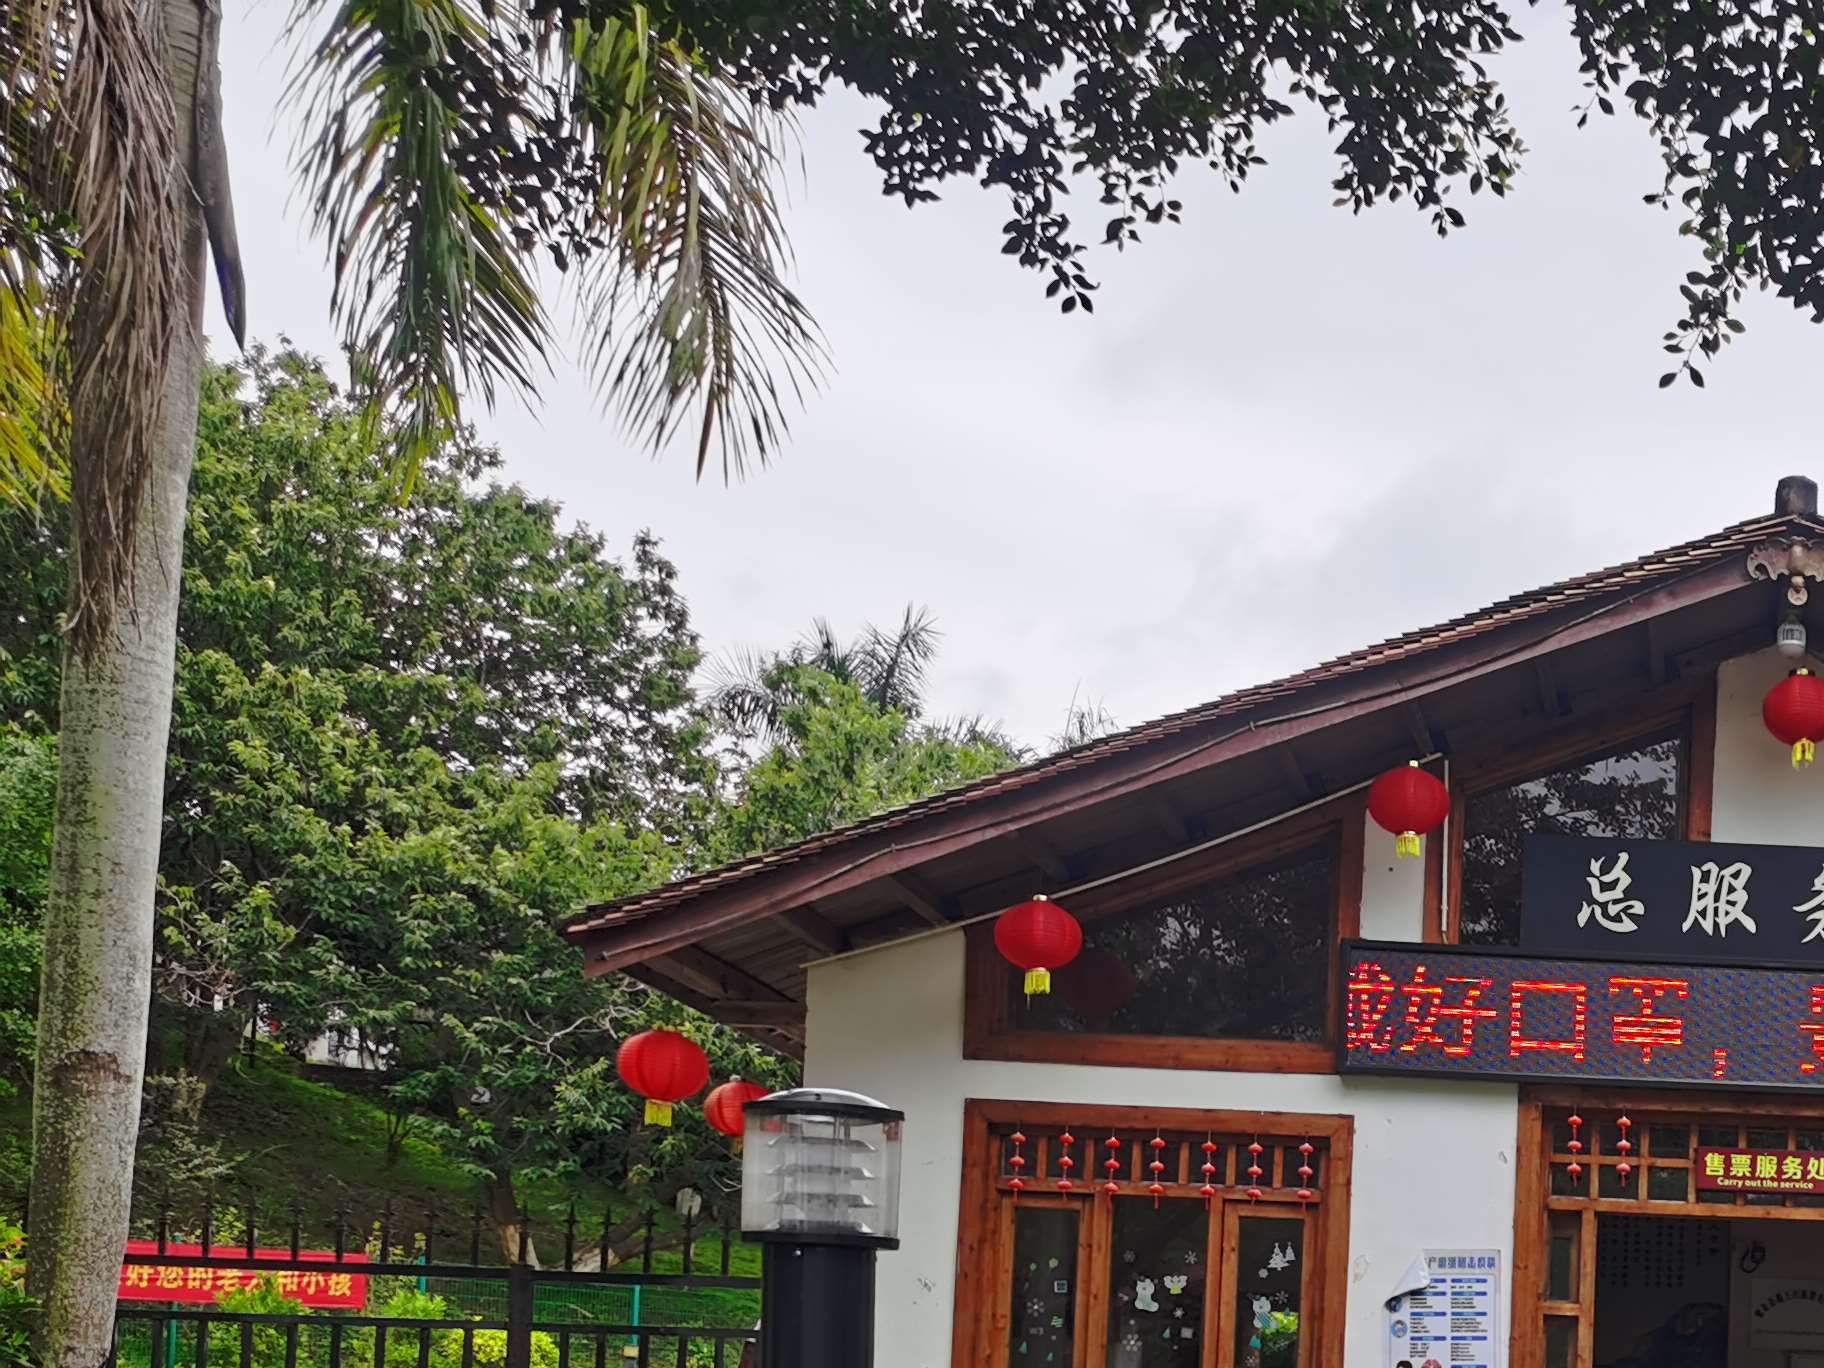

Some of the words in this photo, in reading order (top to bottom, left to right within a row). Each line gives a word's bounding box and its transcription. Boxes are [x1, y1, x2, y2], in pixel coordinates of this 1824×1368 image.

[1717, 1177, 1743, 1188] Carry
[1745, 1179, 1761, 1187] out
[1762, 1179, 1778, 1188] the
[1779, 1180, 1814, 1190] service
